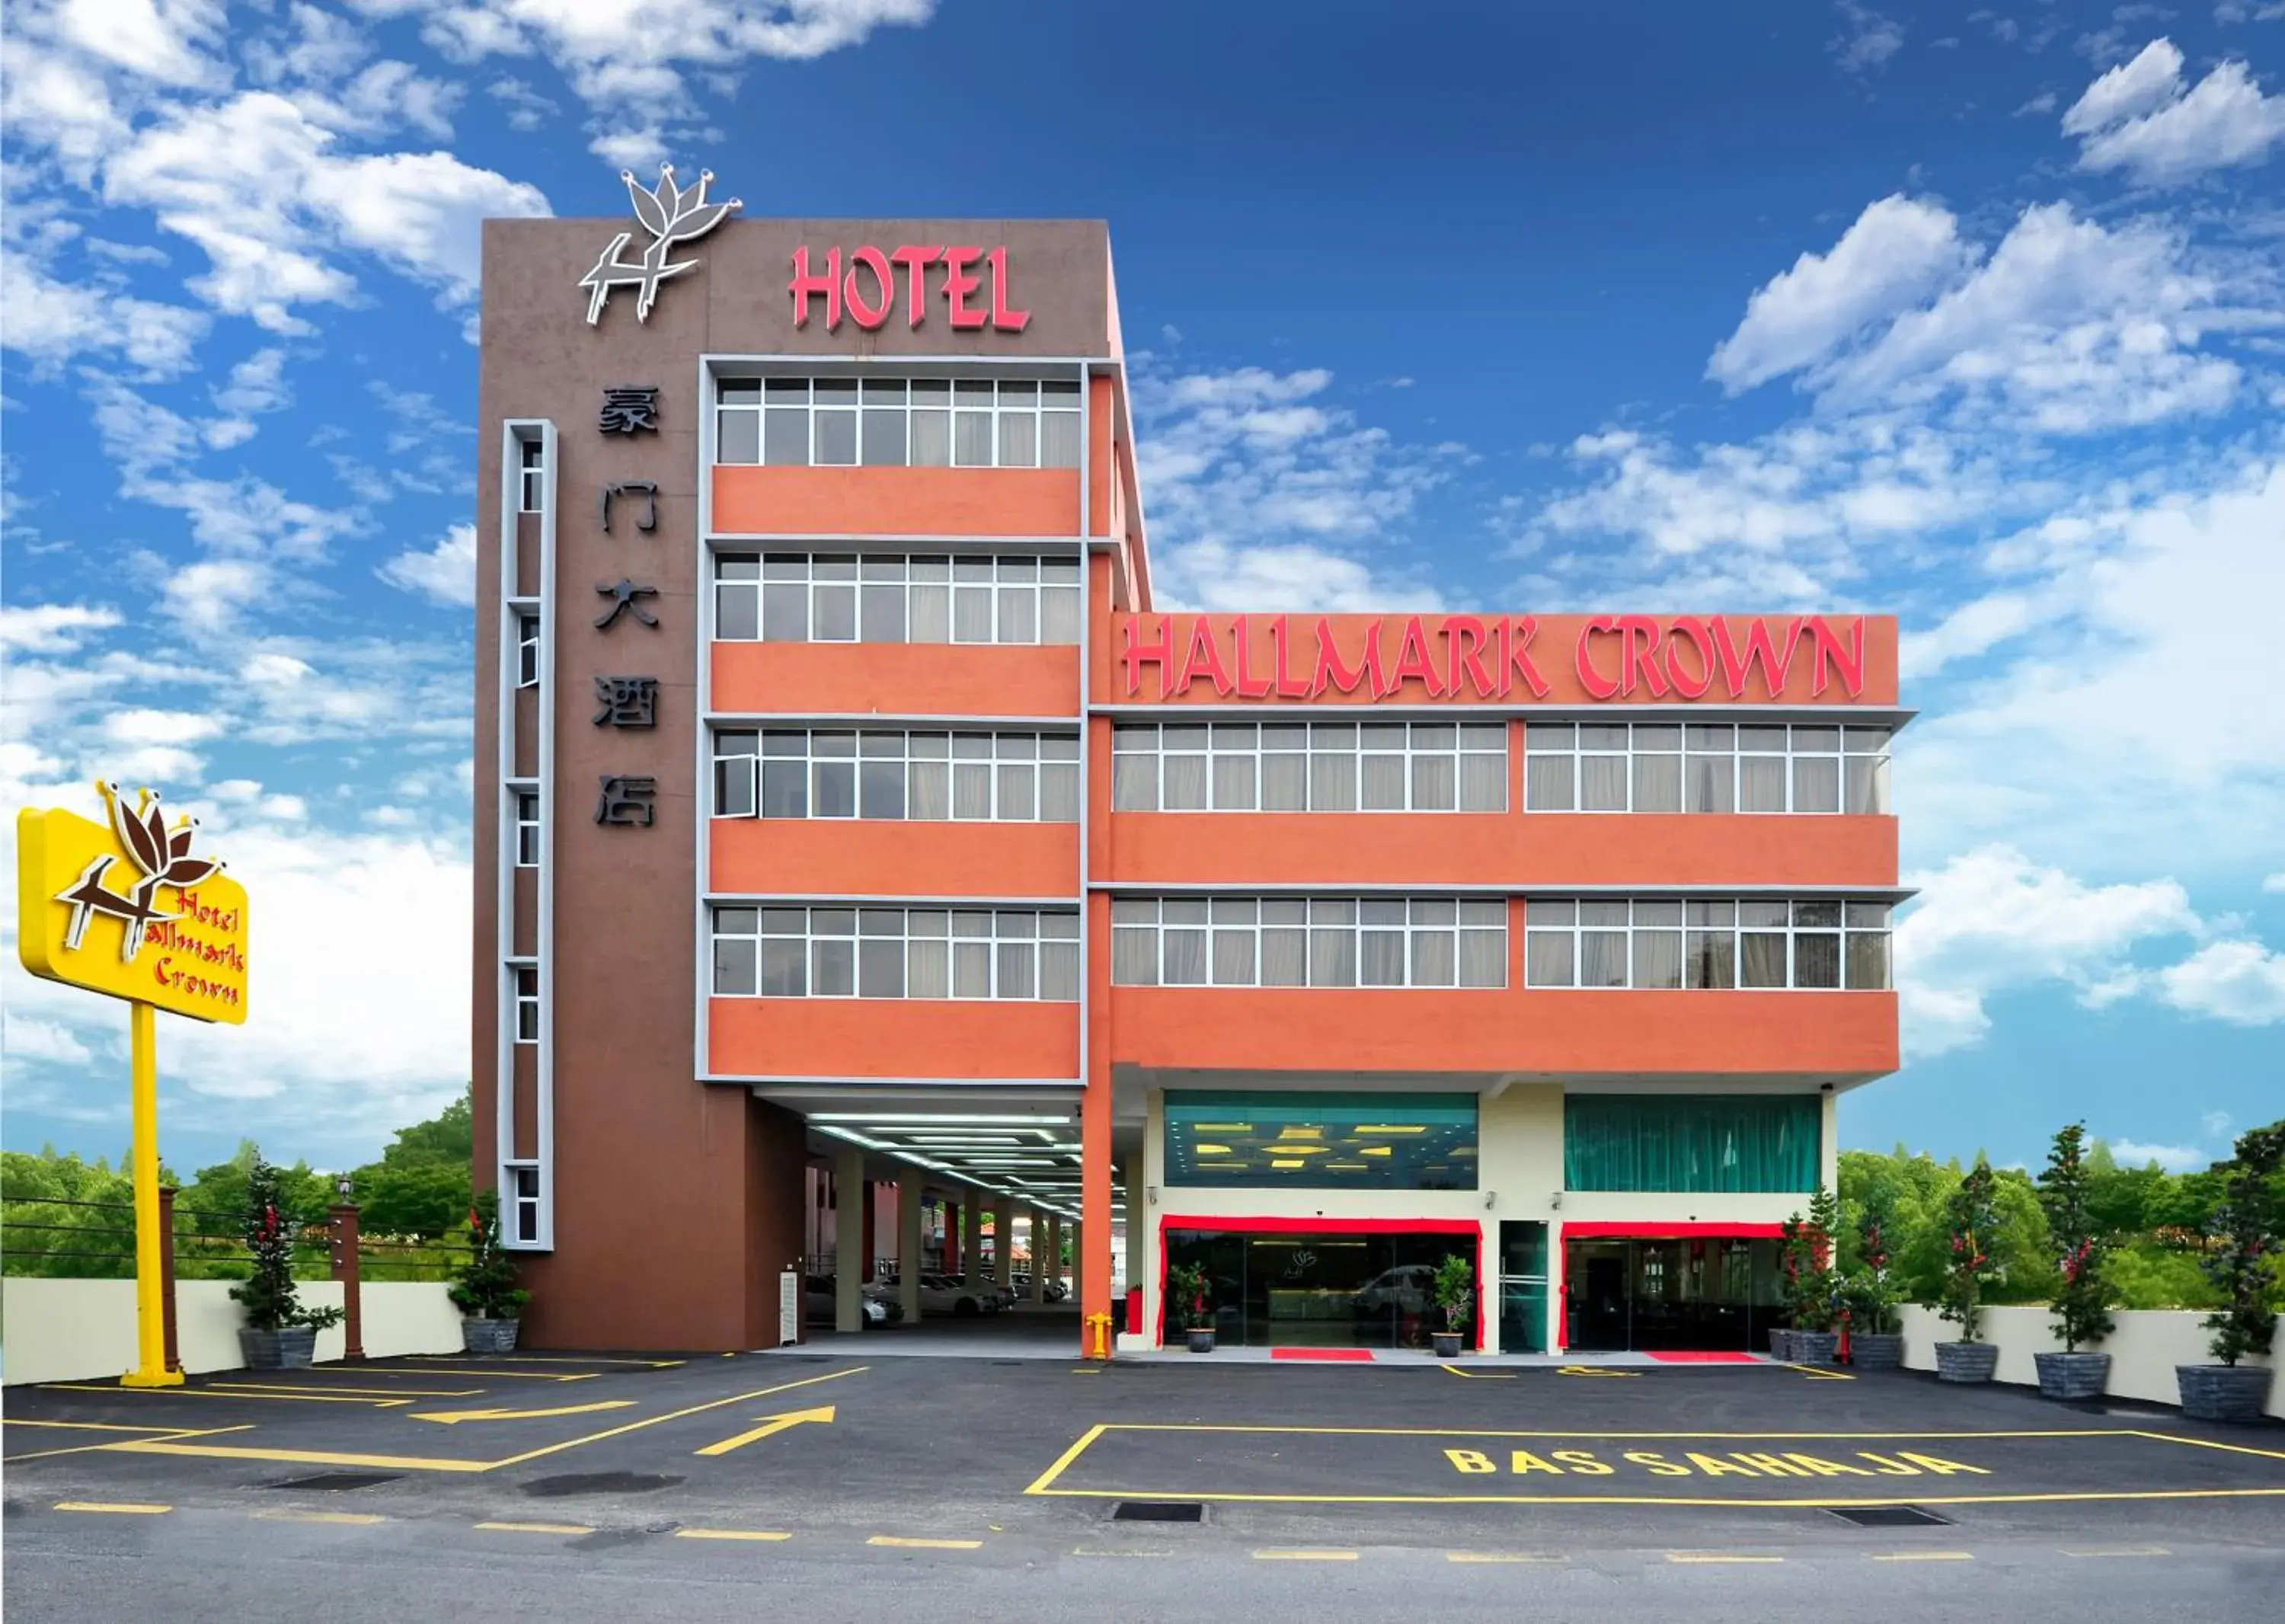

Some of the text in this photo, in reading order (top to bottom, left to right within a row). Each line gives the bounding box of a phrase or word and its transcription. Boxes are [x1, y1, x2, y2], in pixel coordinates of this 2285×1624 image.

[789, 245, 1031, 332] HOTEL
[592, 385, 661, 830] 豪门大酒店
[1122, 614, 1865, 700] HALLMARK CROWN
[175, 887, 238, 932] Hotel
[154, 957, 238, 1005] Crown
[1443, 1449, 1993, 1477] BAS SAHAJA
